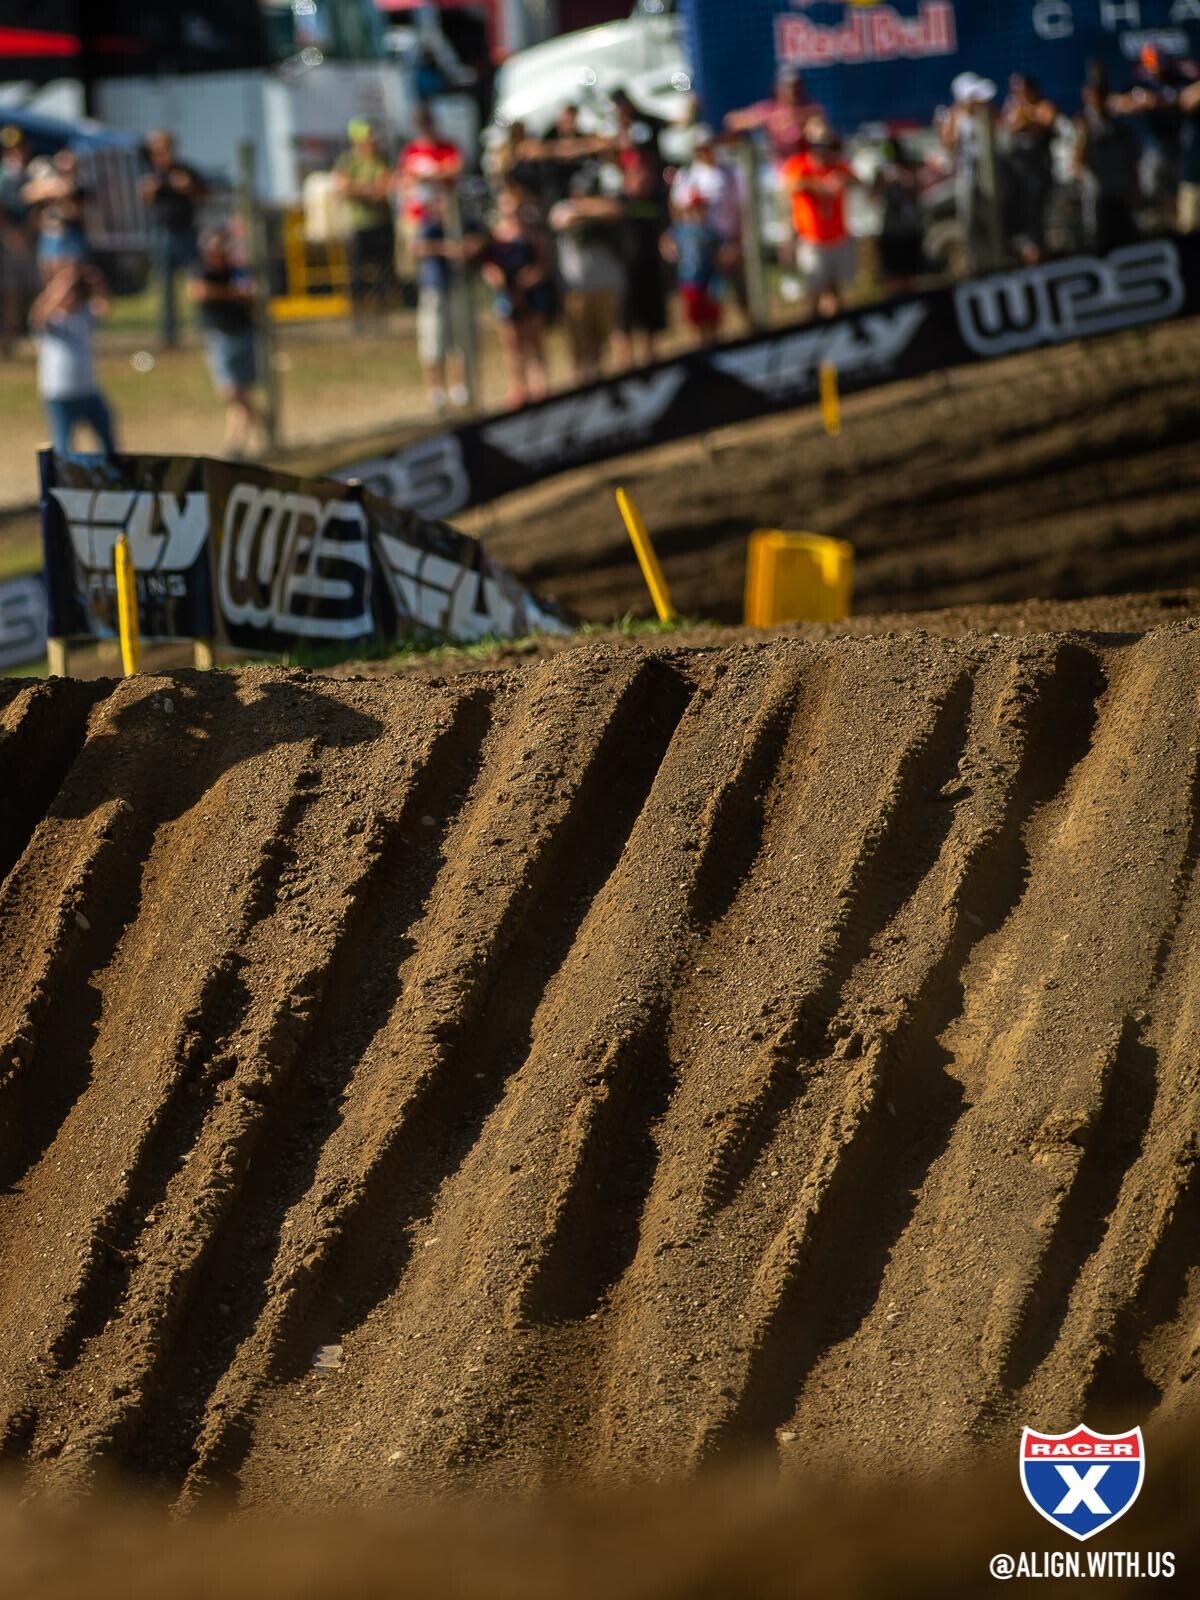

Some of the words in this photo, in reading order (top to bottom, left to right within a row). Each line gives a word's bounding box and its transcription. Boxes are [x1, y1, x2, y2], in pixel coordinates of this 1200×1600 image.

[773, 13, 864, 68] Red
[867, 2, 958, 64] Bull
[954, 239, 1186, 356] WPS
[49, 487, 210, 571] FLY
